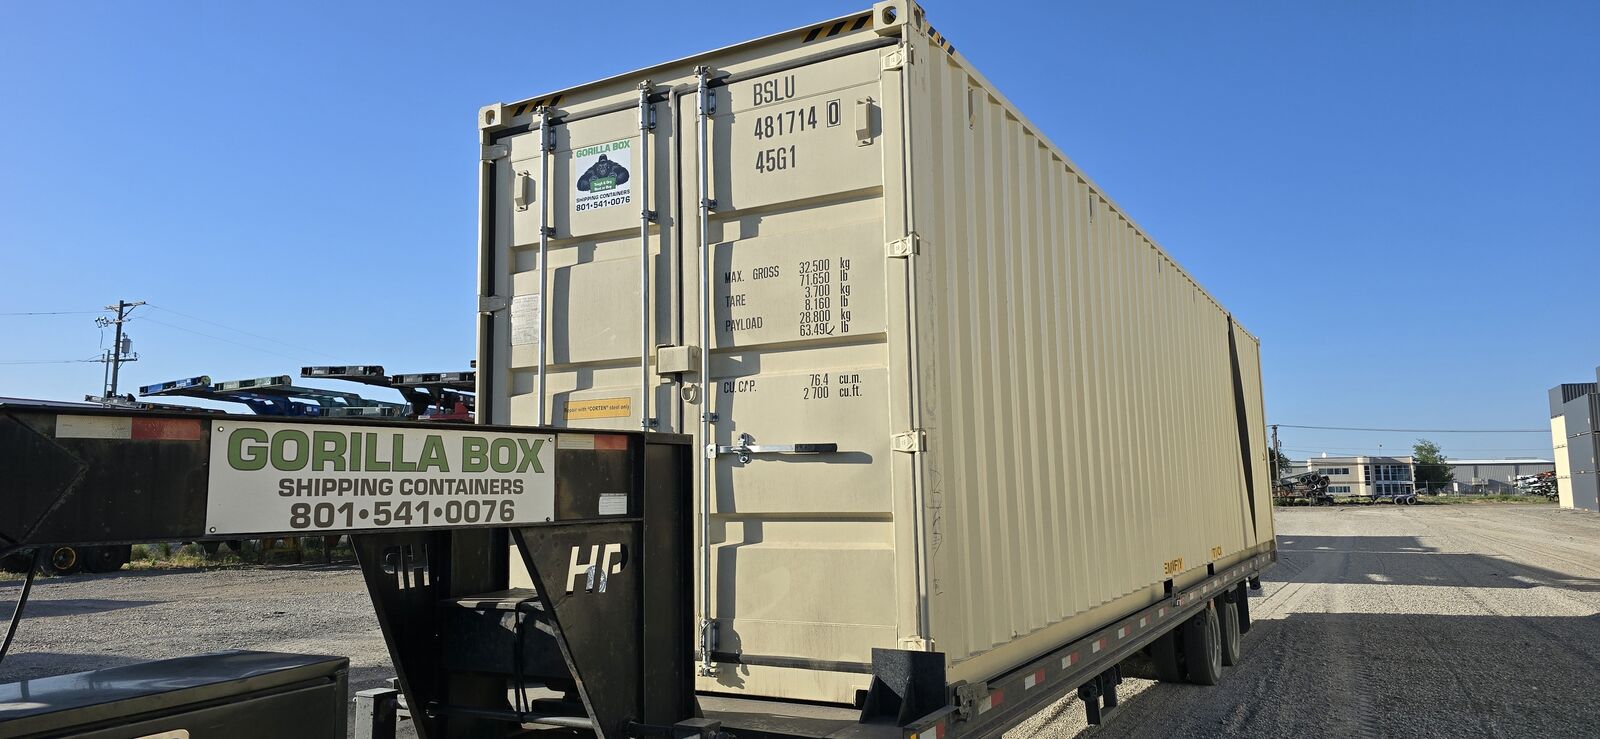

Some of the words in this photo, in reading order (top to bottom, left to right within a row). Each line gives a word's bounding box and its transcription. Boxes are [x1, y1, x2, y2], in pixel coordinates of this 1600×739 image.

[753, 75, 795, 106] BSLU
[754, 106, 817, 140] 481714
[576, 144, 611, 158] GORILLA
[612, 140, 630, 150] BOX
[755, 145, 796, 173] 45G1
[576, 194, 599, 203] SHIPPING
[600, 189, 631, 199] CONTAINERS
[724, 270, 745, 283] MAX.
[752, 265, 780, 280] GROSS
[799, 259, 830, 274] 32.500
[840, 256, 850, 270] kg
[799, 271, 830, 286] 71.650
[840, 269, 848, 281] lb
[725, 294, 746, 307] TARE
[804, 284, 830, 298] 3.700
[840, 282, 850, 296] kg
[804, 297, 830, 311] 8.160
[840, 295, 848, 307] lb
[725, 316, 763, 332] PAYLOAD
[799, 309, 831, 324] 28.800
[840, 308, 851, 322] kg
[841, 320, 849, 333] lb
[809, 373, 829, 387] 76.4
[839, 373, 862, 385] cu.m.
[839, 384, 862, 397] cu.ft.
[227, 427, 450, 473] GORILLA
[461, 436, 545, 474] BOX
[278, 477, 393, 497] SHIPPING
[399, 477, 524, 496] CONTAINERS
[566, 543, 629, 594] HP
